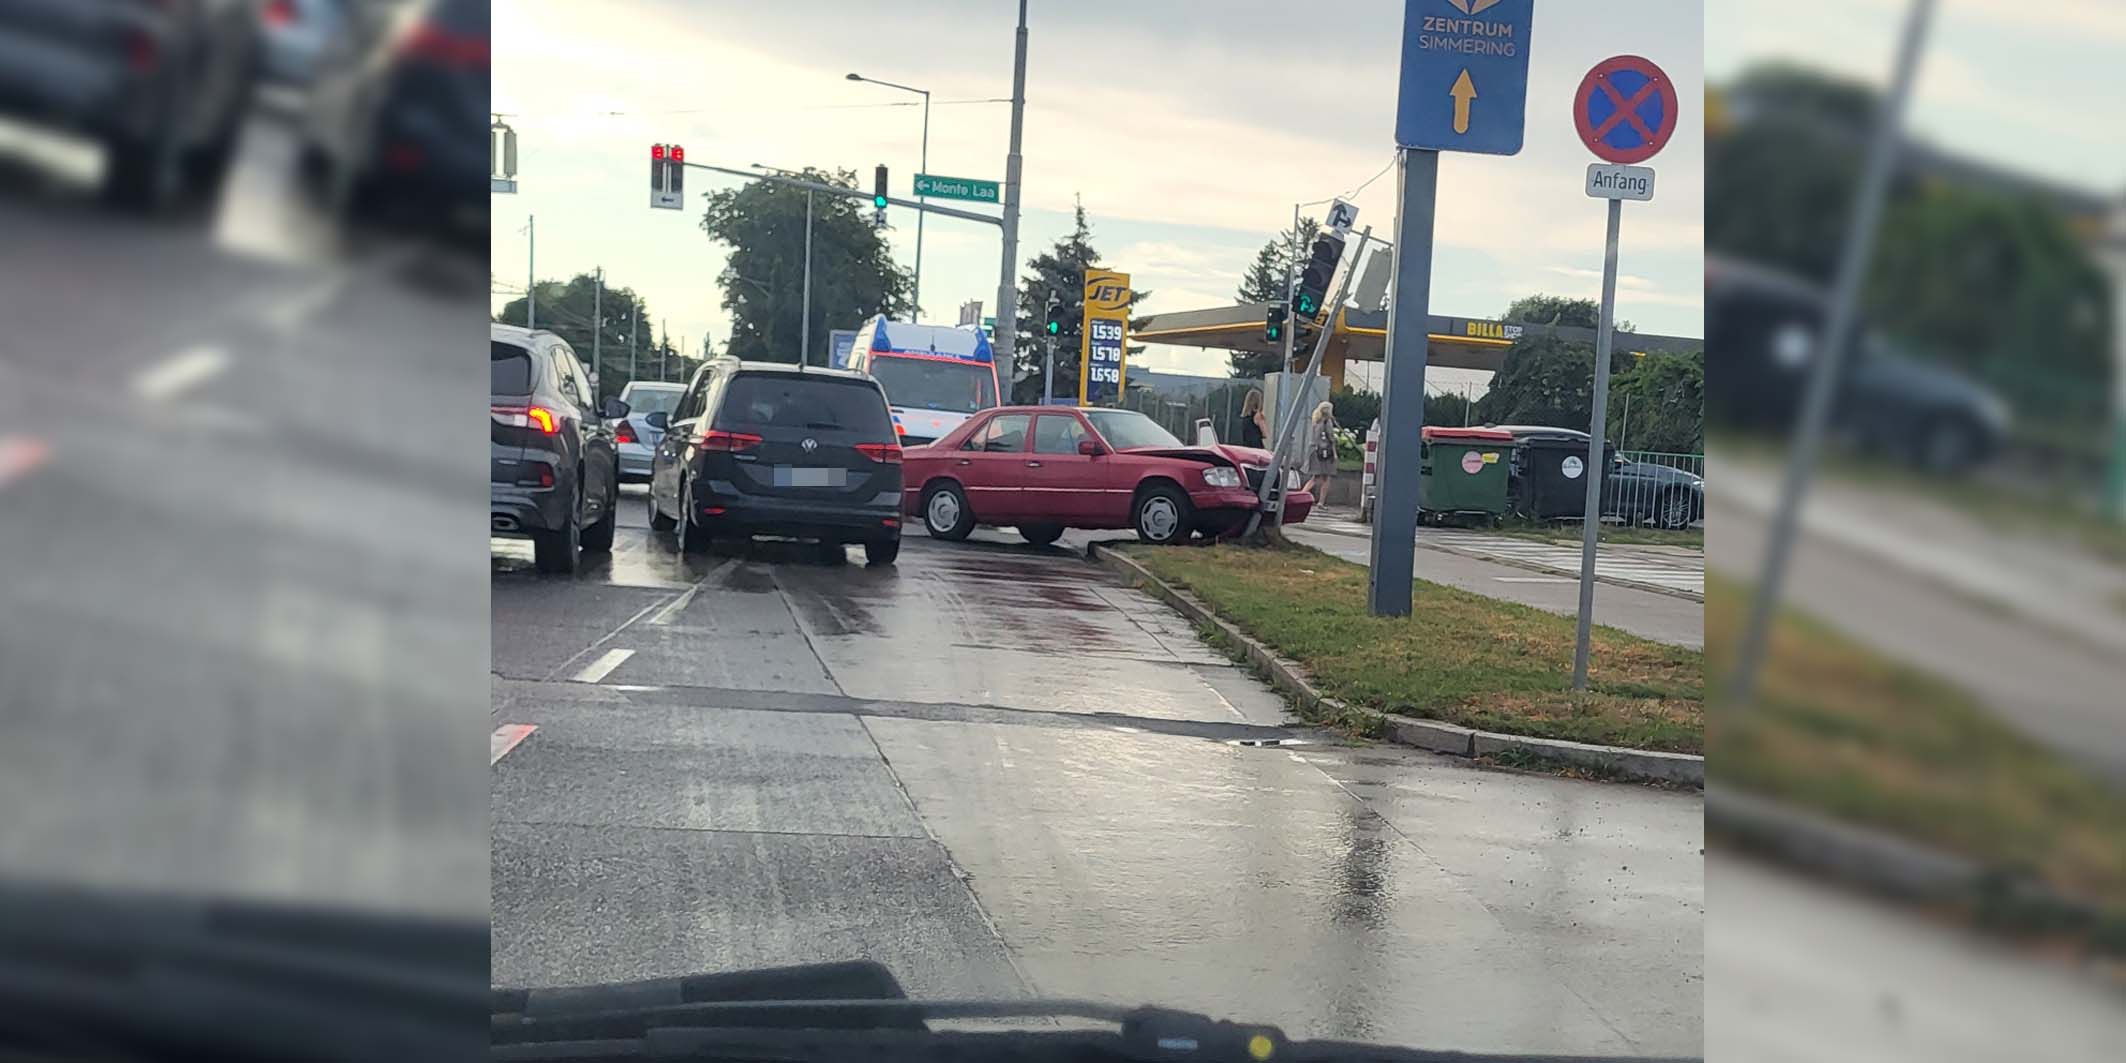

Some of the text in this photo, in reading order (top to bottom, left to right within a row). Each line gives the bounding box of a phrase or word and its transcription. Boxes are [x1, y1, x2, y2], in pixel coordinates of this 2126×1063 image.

[1423, 16, 1513, 38] ZENTRUM
[1419, 35, 1516, 57] SIMMERING
[932, 181, 995, 198] Monte Laa
[1593, 171, 1647, 195] Anfang
[1088, 285, 1127, 301] JET
[1467, 321, 1504, 337] BILLA
